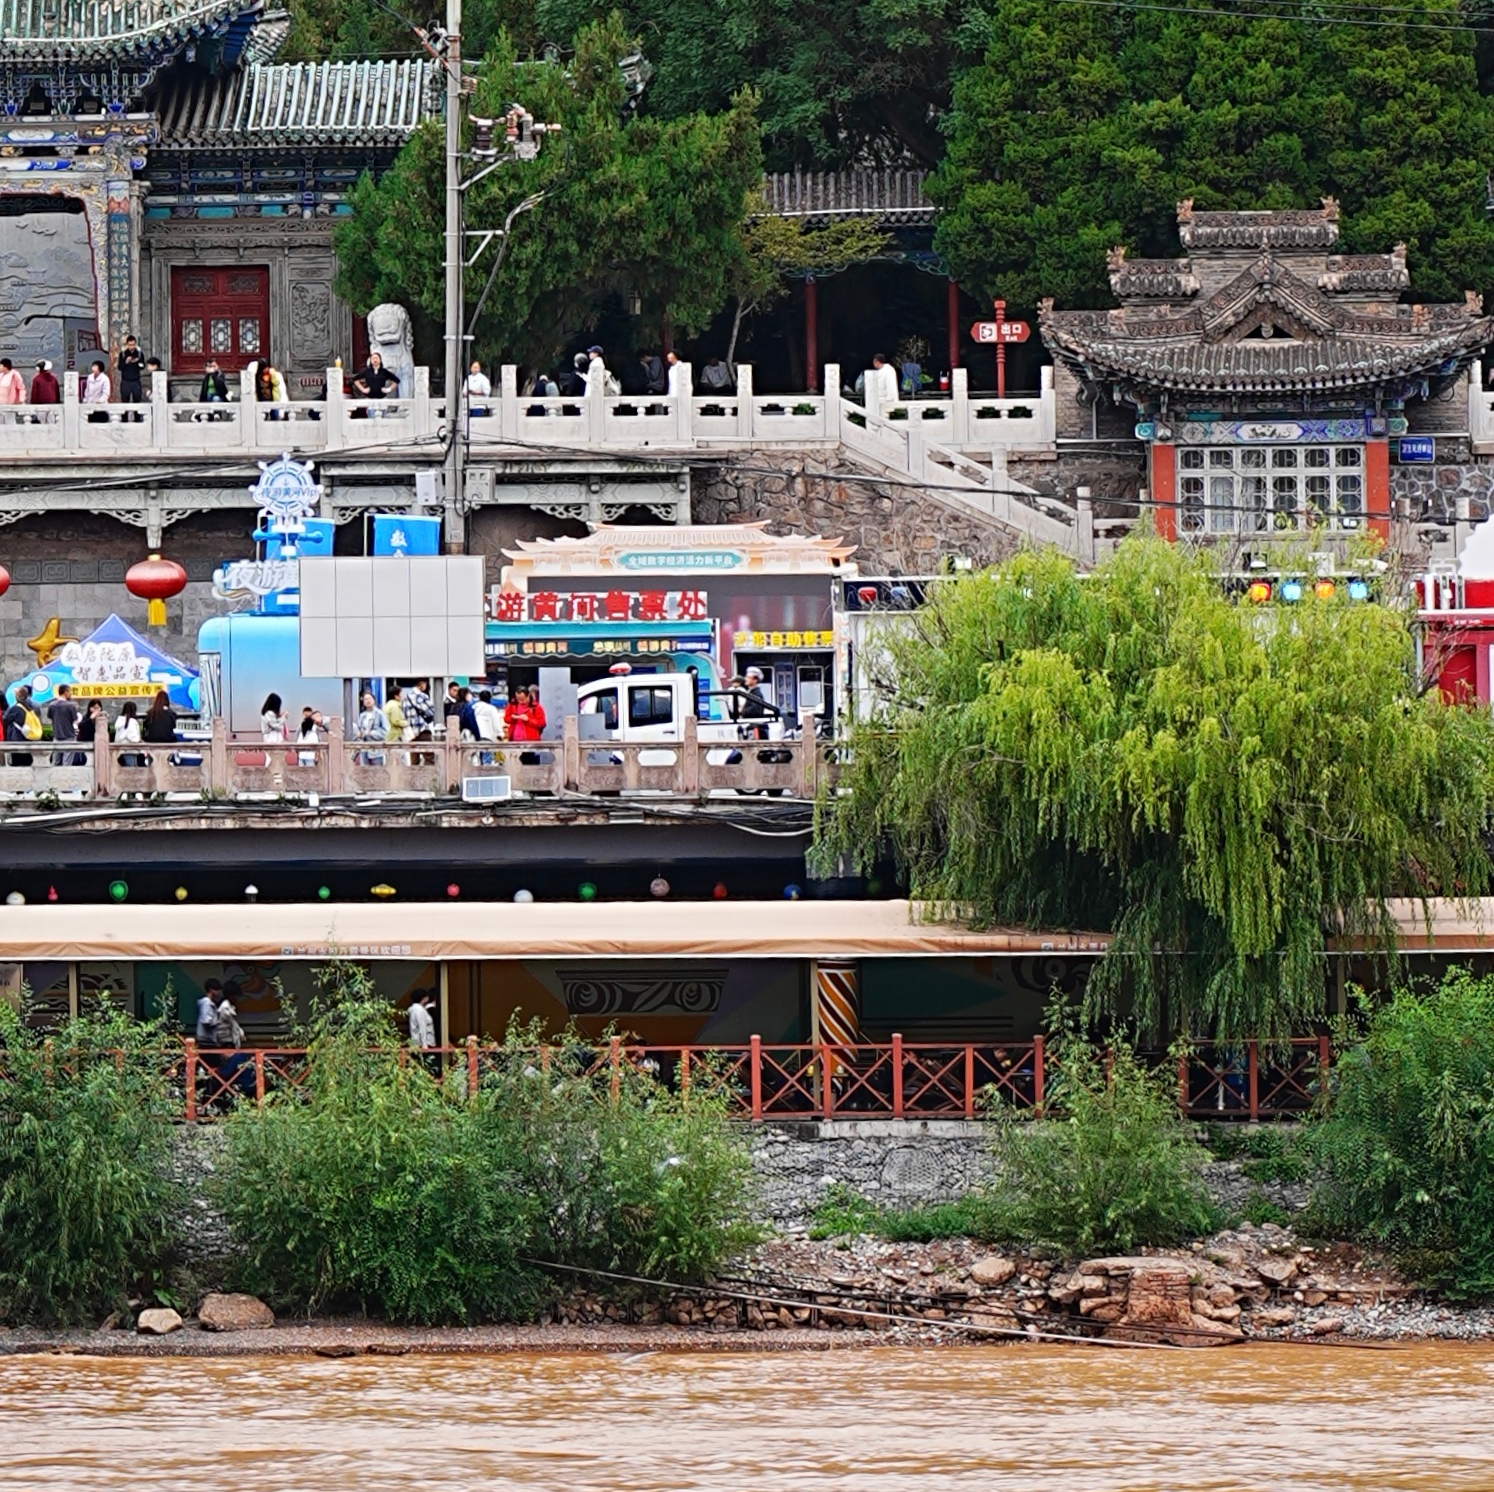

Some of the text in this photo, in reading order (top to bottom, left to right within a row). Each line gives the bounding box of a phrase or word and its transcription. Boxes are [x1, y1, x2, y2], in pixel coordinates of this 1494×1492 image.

[1001, 323, 1022, 335] 出口
[486, 589, 708, 621] 游黄河售票处
